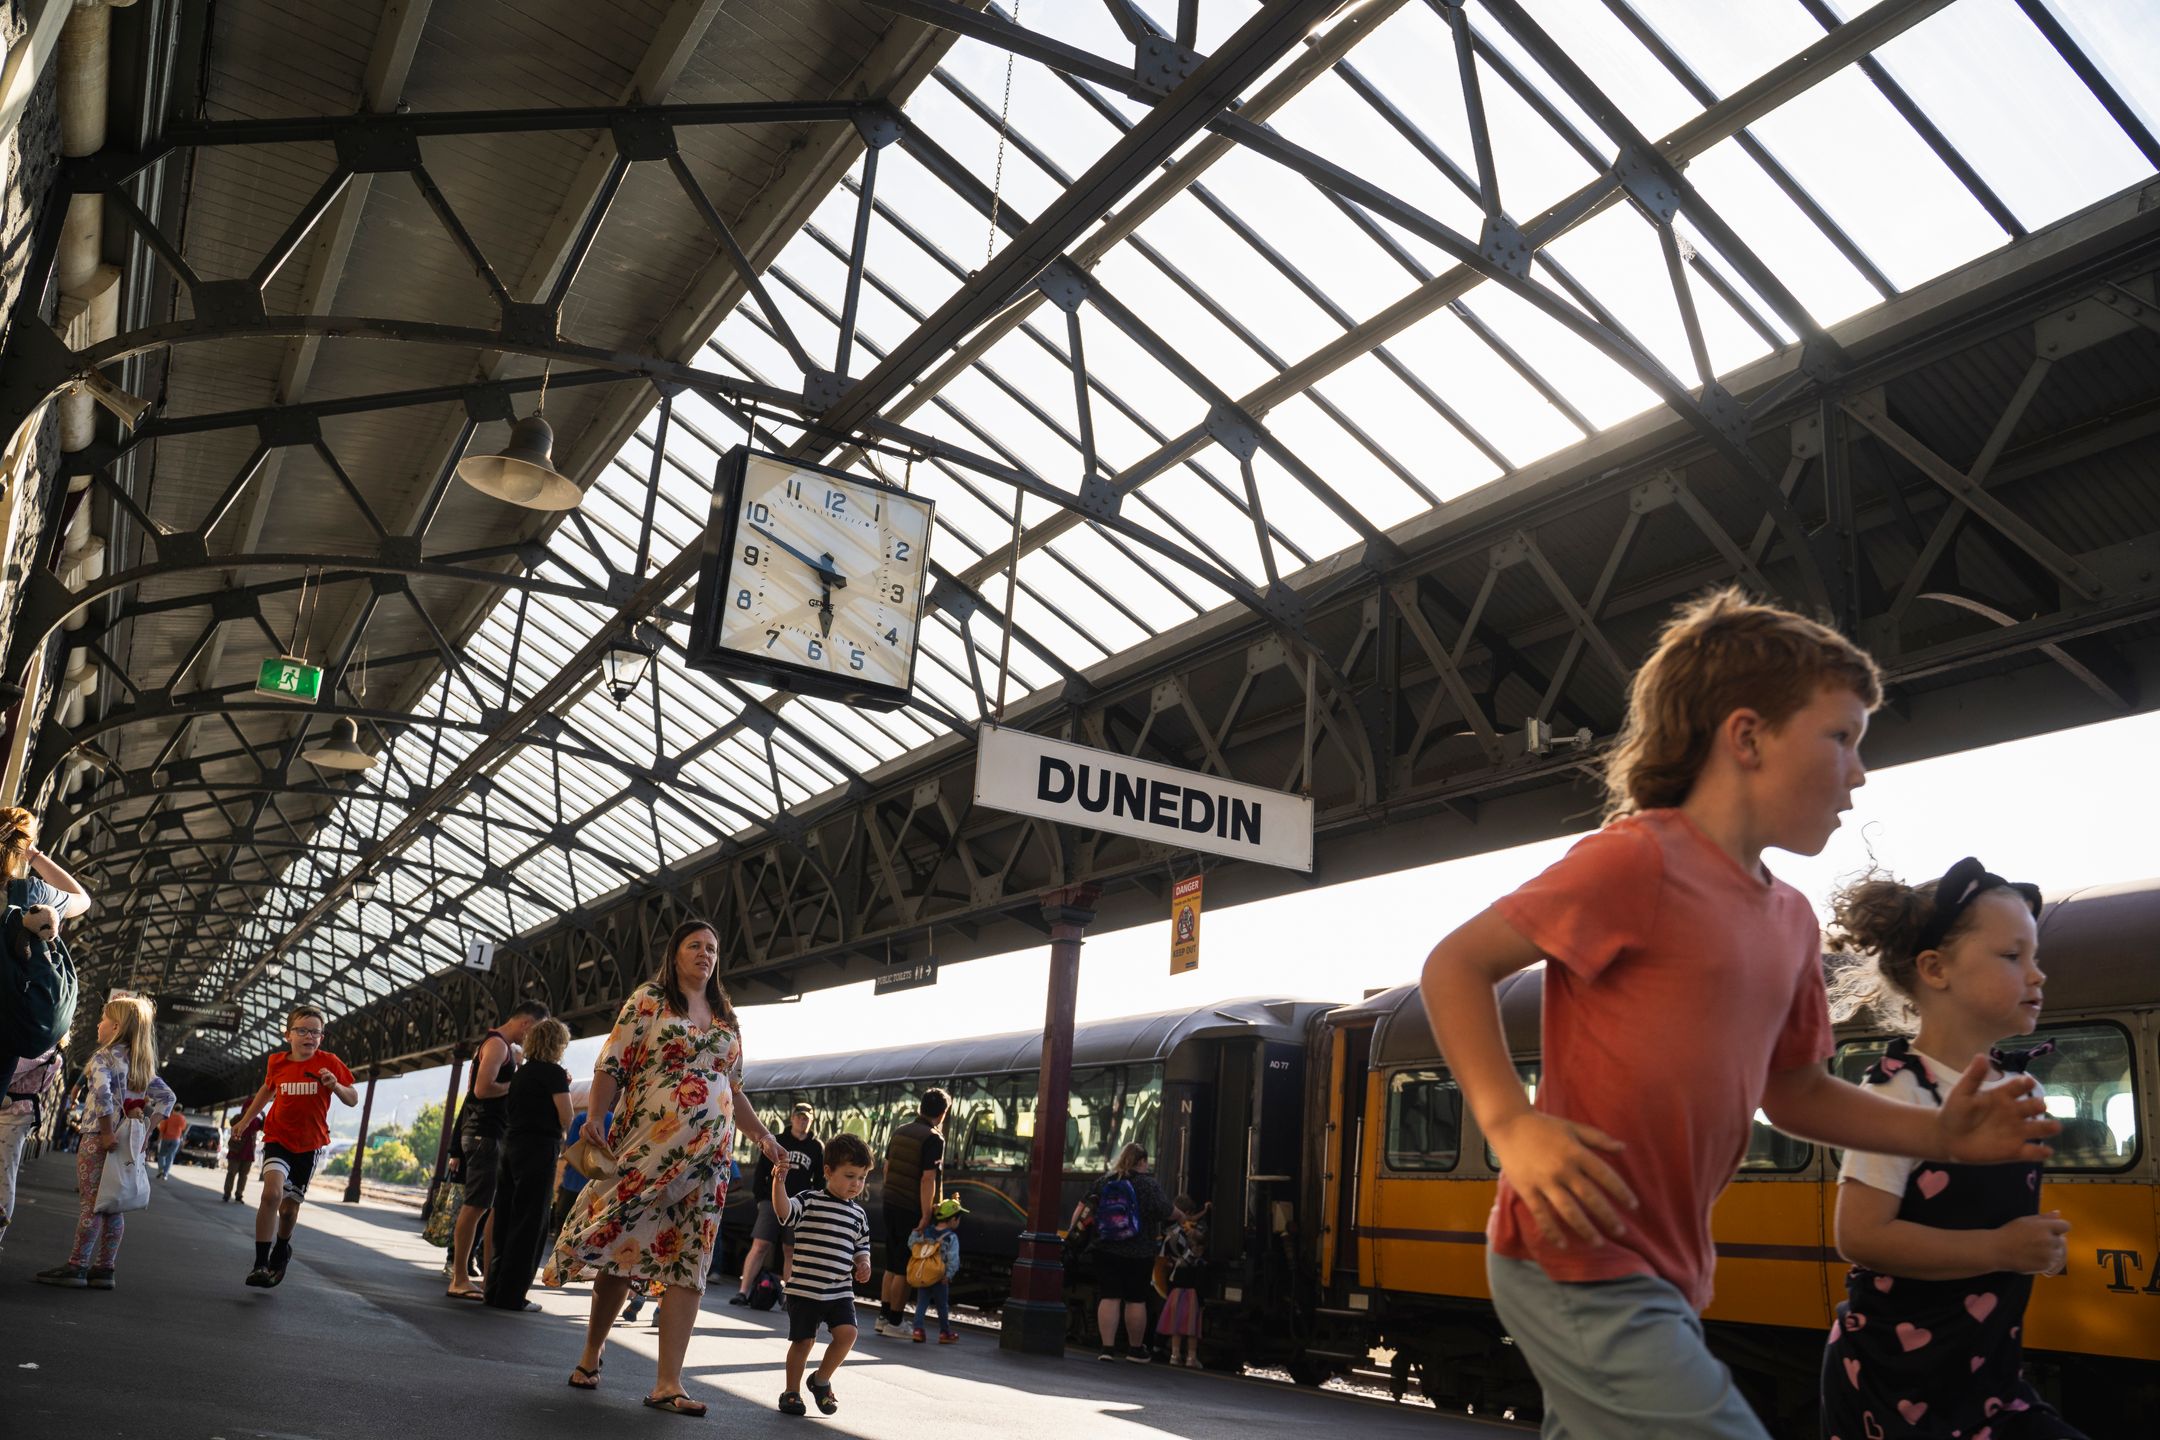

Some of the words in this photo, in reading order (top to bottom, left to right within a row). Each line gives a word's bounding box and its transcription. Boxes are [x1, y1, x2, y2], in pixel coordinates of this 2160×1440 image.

[786, 479, 802, 501] 11
[825, 489, 847, 513] 12
[746, 501, 769, 524] 10
[874, 503, 880, 522] 1
[743, 545, 759, 566] 9
[894, 541, 910, 562] 2
[735, 589, 752, 610] 8
[889, 583, 905, 604] 3
[765, 629, 780, 649] 7
[884, 627, 899, 646] 4
[807, 639, 823, 661] 6
[850, 649, 865, 671] 5
[1037, 755, 1262, 845] DUNEDIN
[1175, 880, 1199, 896] DANGER
[473, 944, 485, 965] 1
[171, 1004, 214, 1016] RESTAURANT
[280, 1081, 318, 1096] PUMA
